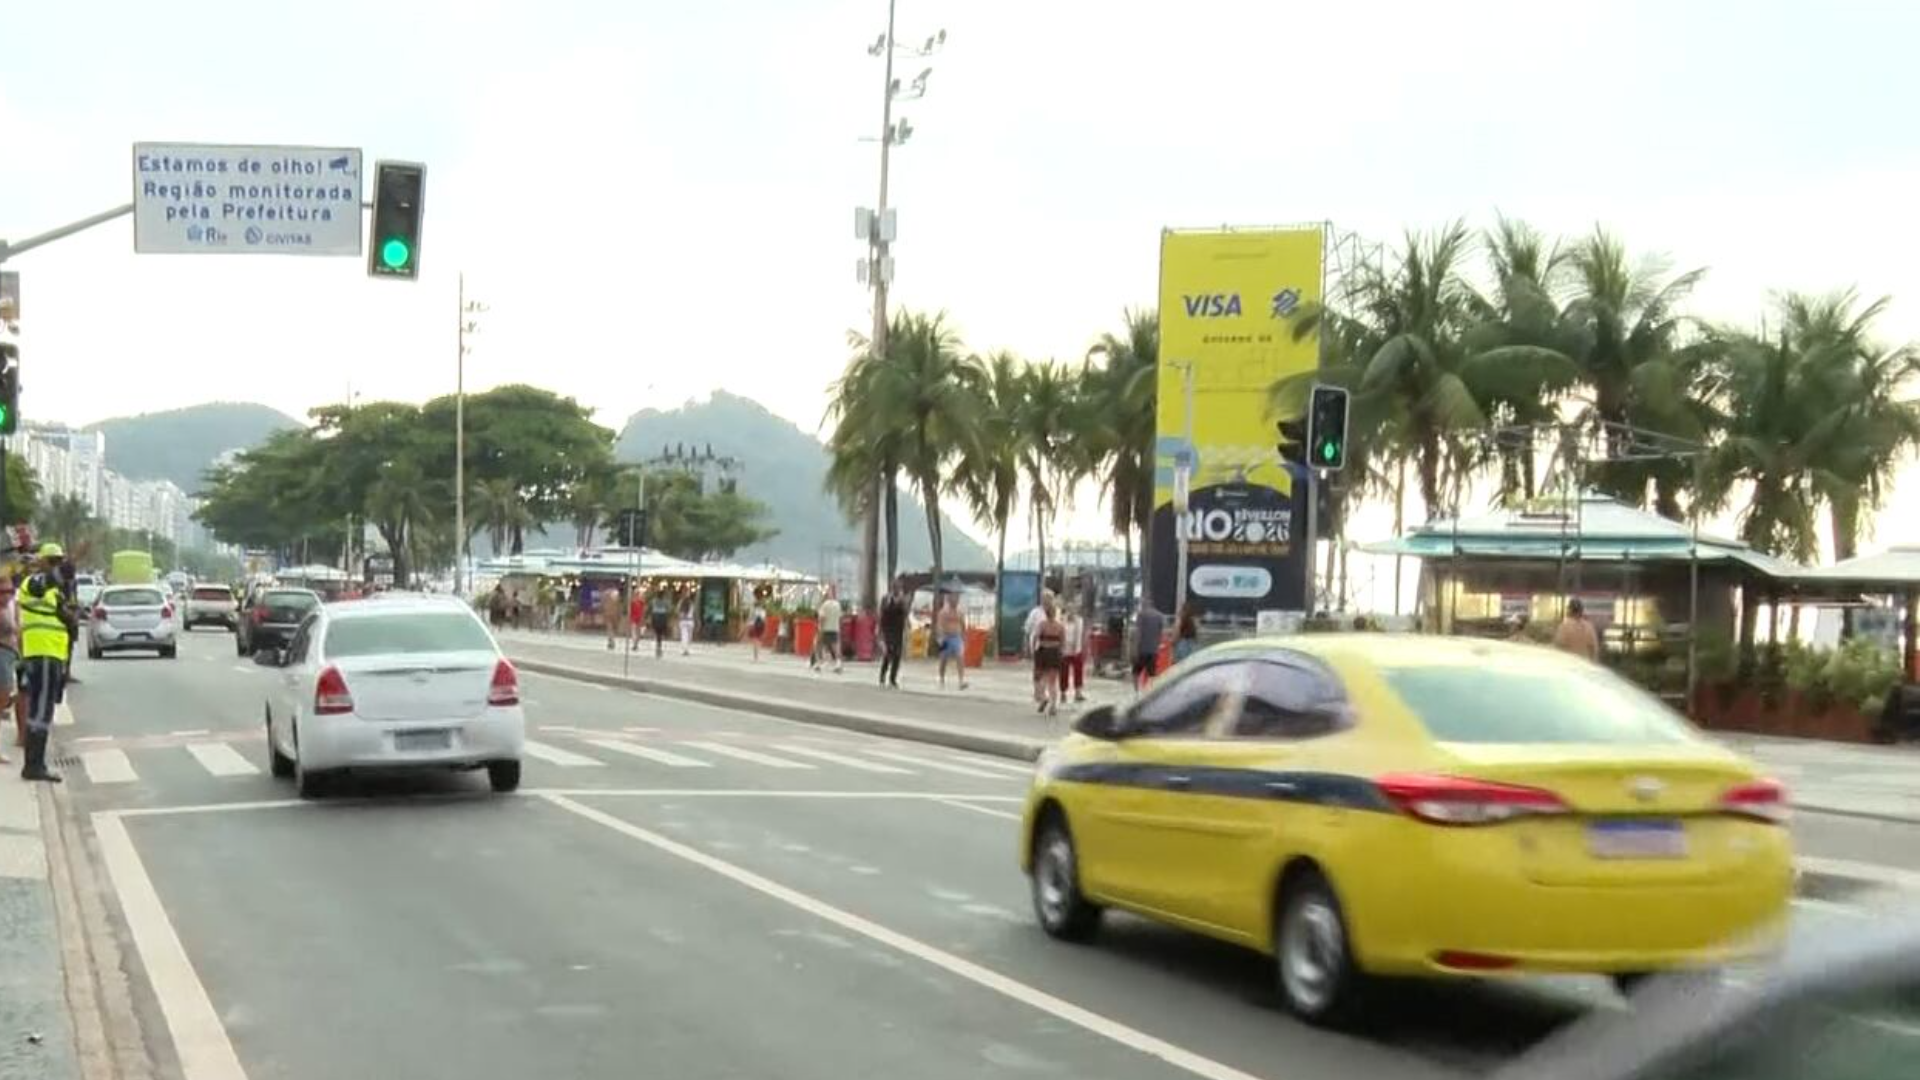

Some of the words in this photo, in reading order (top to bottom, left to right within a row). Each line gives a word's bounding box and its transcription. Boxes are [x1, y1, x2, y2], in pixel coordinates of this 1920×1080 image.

[138, 155, 228, 172] Estamos
[238, 159, 261, 173] de
[271, 159, 322, 174] olho!
[144, 180, 217, 201] Região
[229, 183, 353, 200] monitorada
[166, 203, 210, 221] pela
[222, 203, 332, 221] Prefeitura
[1182, 294, 1242, 317] VISA
[1175, 509, 1233, 541] RIO
